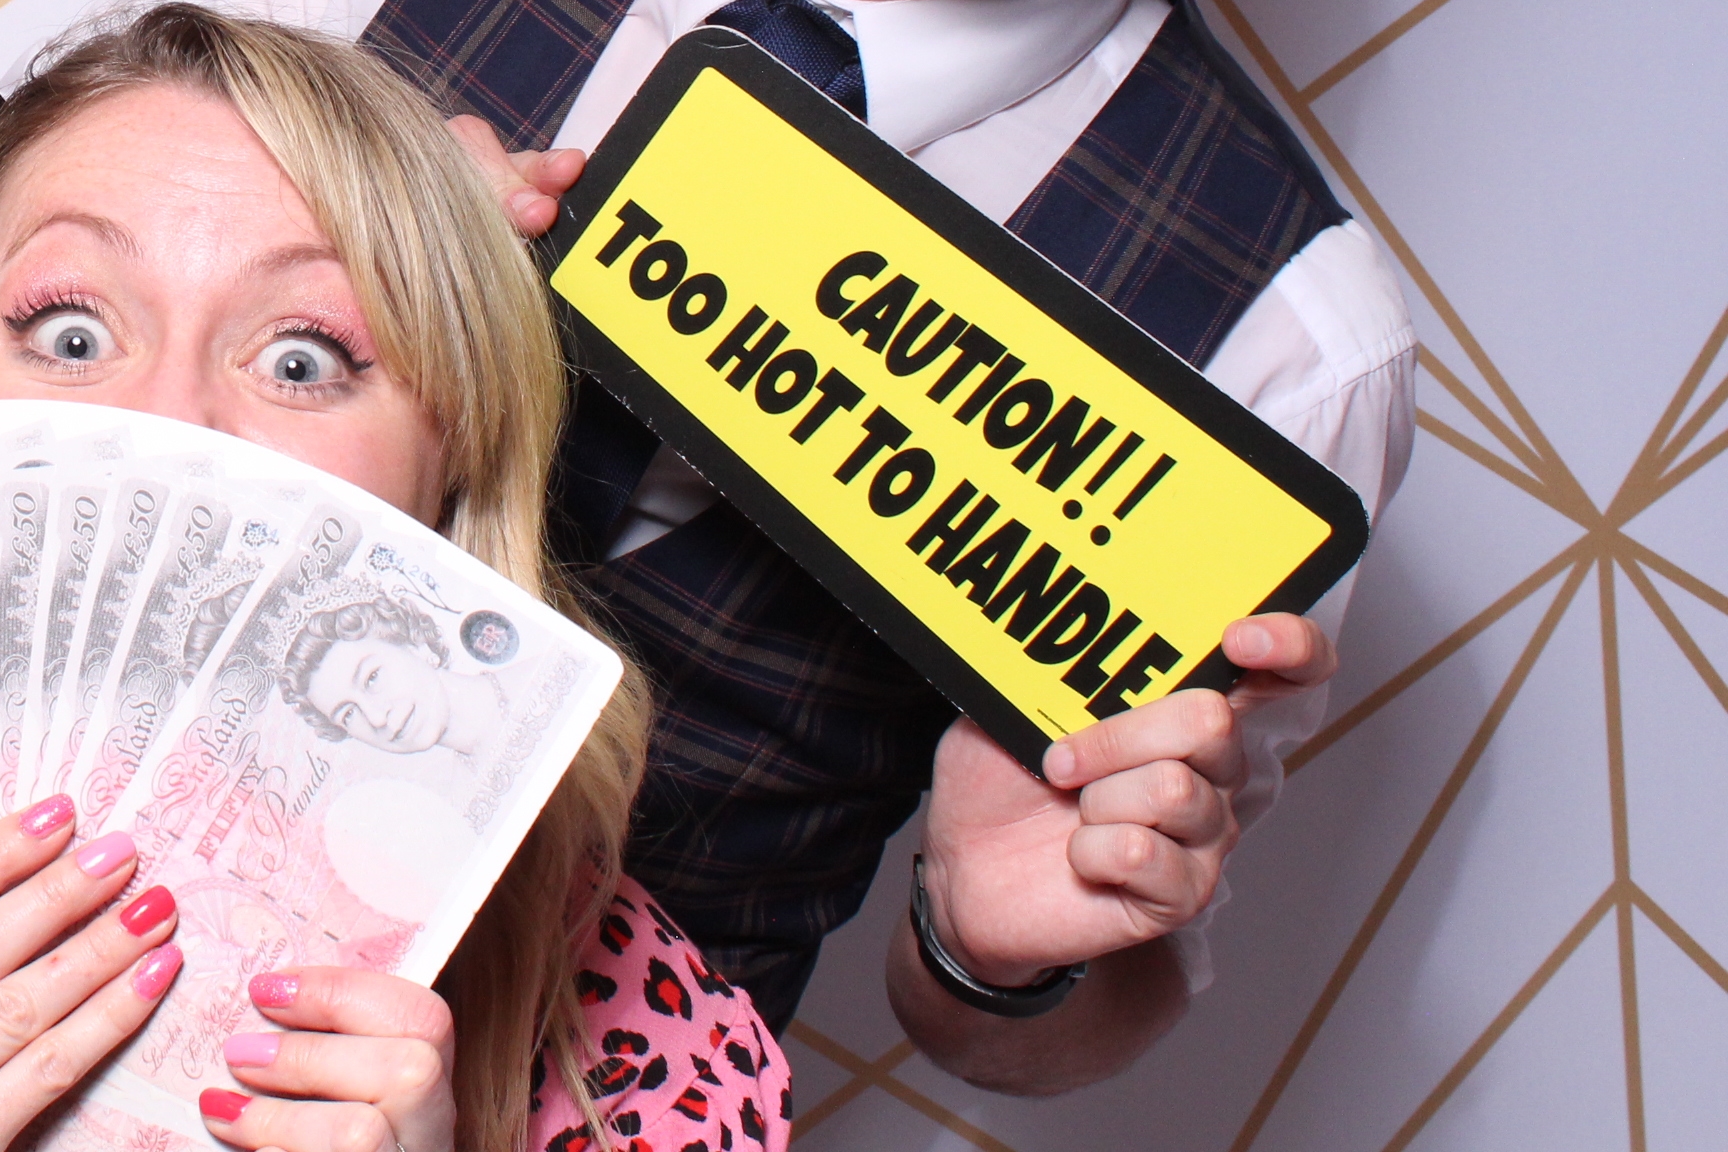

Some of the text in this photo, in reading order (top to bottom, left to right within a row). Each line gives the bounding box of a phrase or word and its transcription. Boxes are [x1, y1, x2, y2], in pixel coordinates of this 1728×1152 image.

[816, 251, 1177, 546] CAUTION!!
[595, 200, 1184, 721] TOO HOT TO HANDLE
[12, 491, 38, 571] £50
[70, 495, 98, 572] £50
[123, 489, 156, 571] £50
[177, 504, 214, 579] £50
[298, 516, 345, 586] £50
[152, 686, 248, 810] England
[192, 753, 268, 864] FIFTY
[237, 750, 331, 881] Pounds
